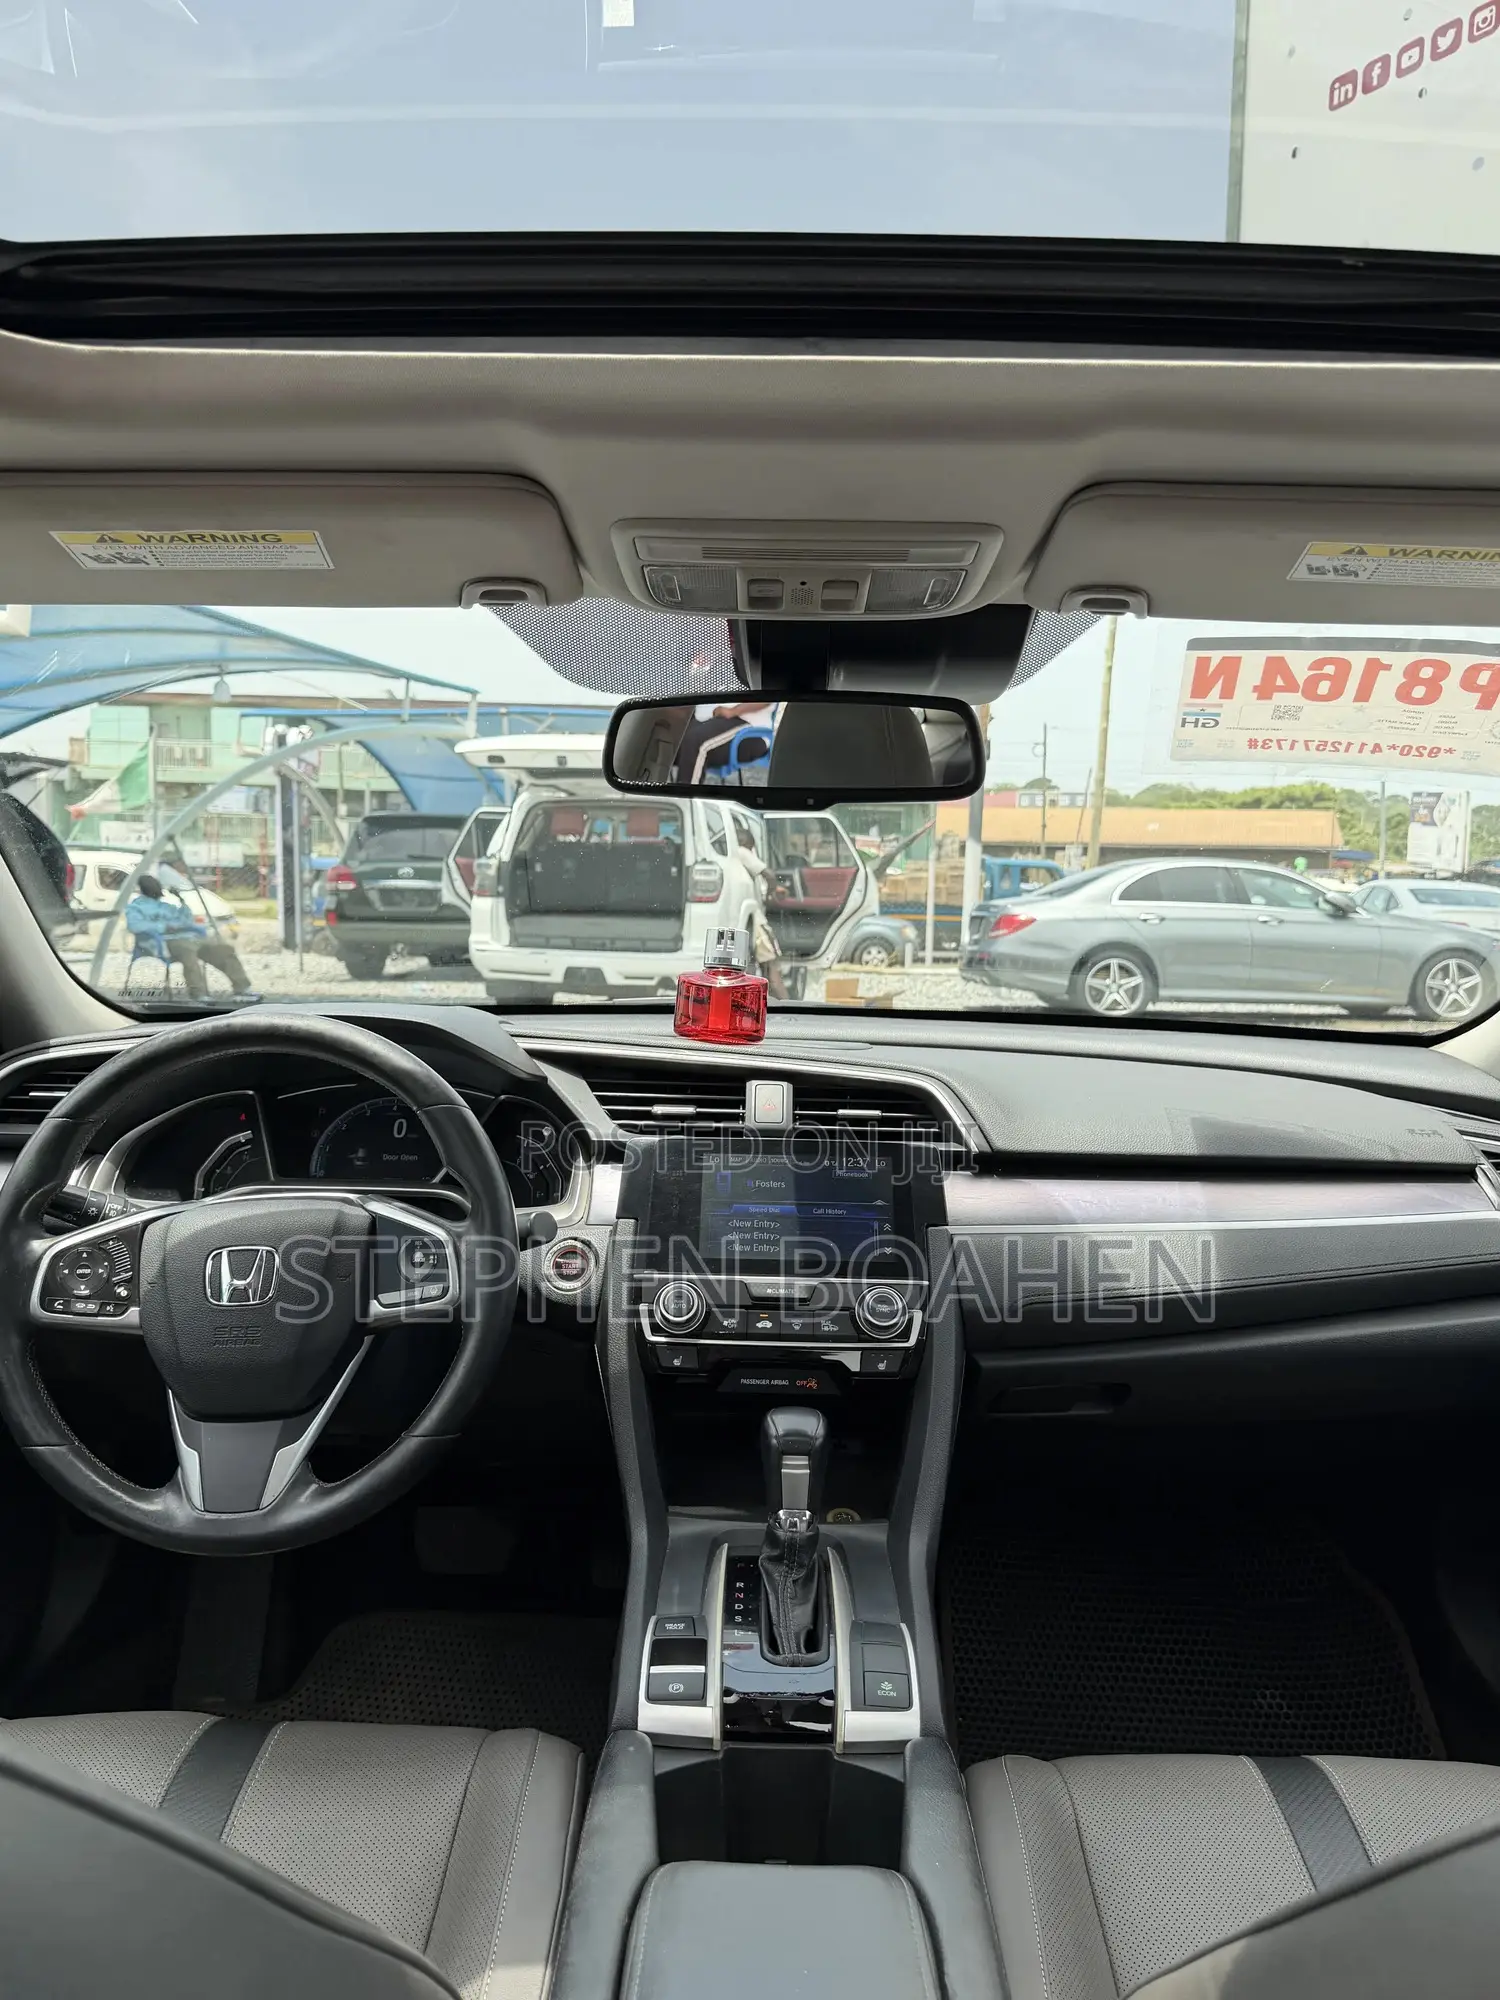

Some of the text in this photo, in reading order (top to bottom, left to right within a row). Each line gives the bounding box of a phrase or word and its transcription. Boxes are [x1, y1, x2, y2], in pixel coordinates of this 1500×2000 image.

[137, 533, 282, 543] WARNING
[1402, 559, 1472, 567] ADVANCED
[393, 1118, 407, 1138] 0
[382, 1153, 418, 1161] Door Open
[842, 1157, 869, 1167] 12:37
[835, 1170, 869, 1178] Phonebook
[755, 1179, 786, 1189] Fosters
[748, 1206, 767, 1214] Speed
[826, 1208, 847, 1216] History
[728, 1219, 781, 1229] <New Entry>
[727, 1231, 780, 1241] <New Entry>
[727, 1243, 780, 1253] <New Entry>
[877, 1689, 897, 1698] ECON
